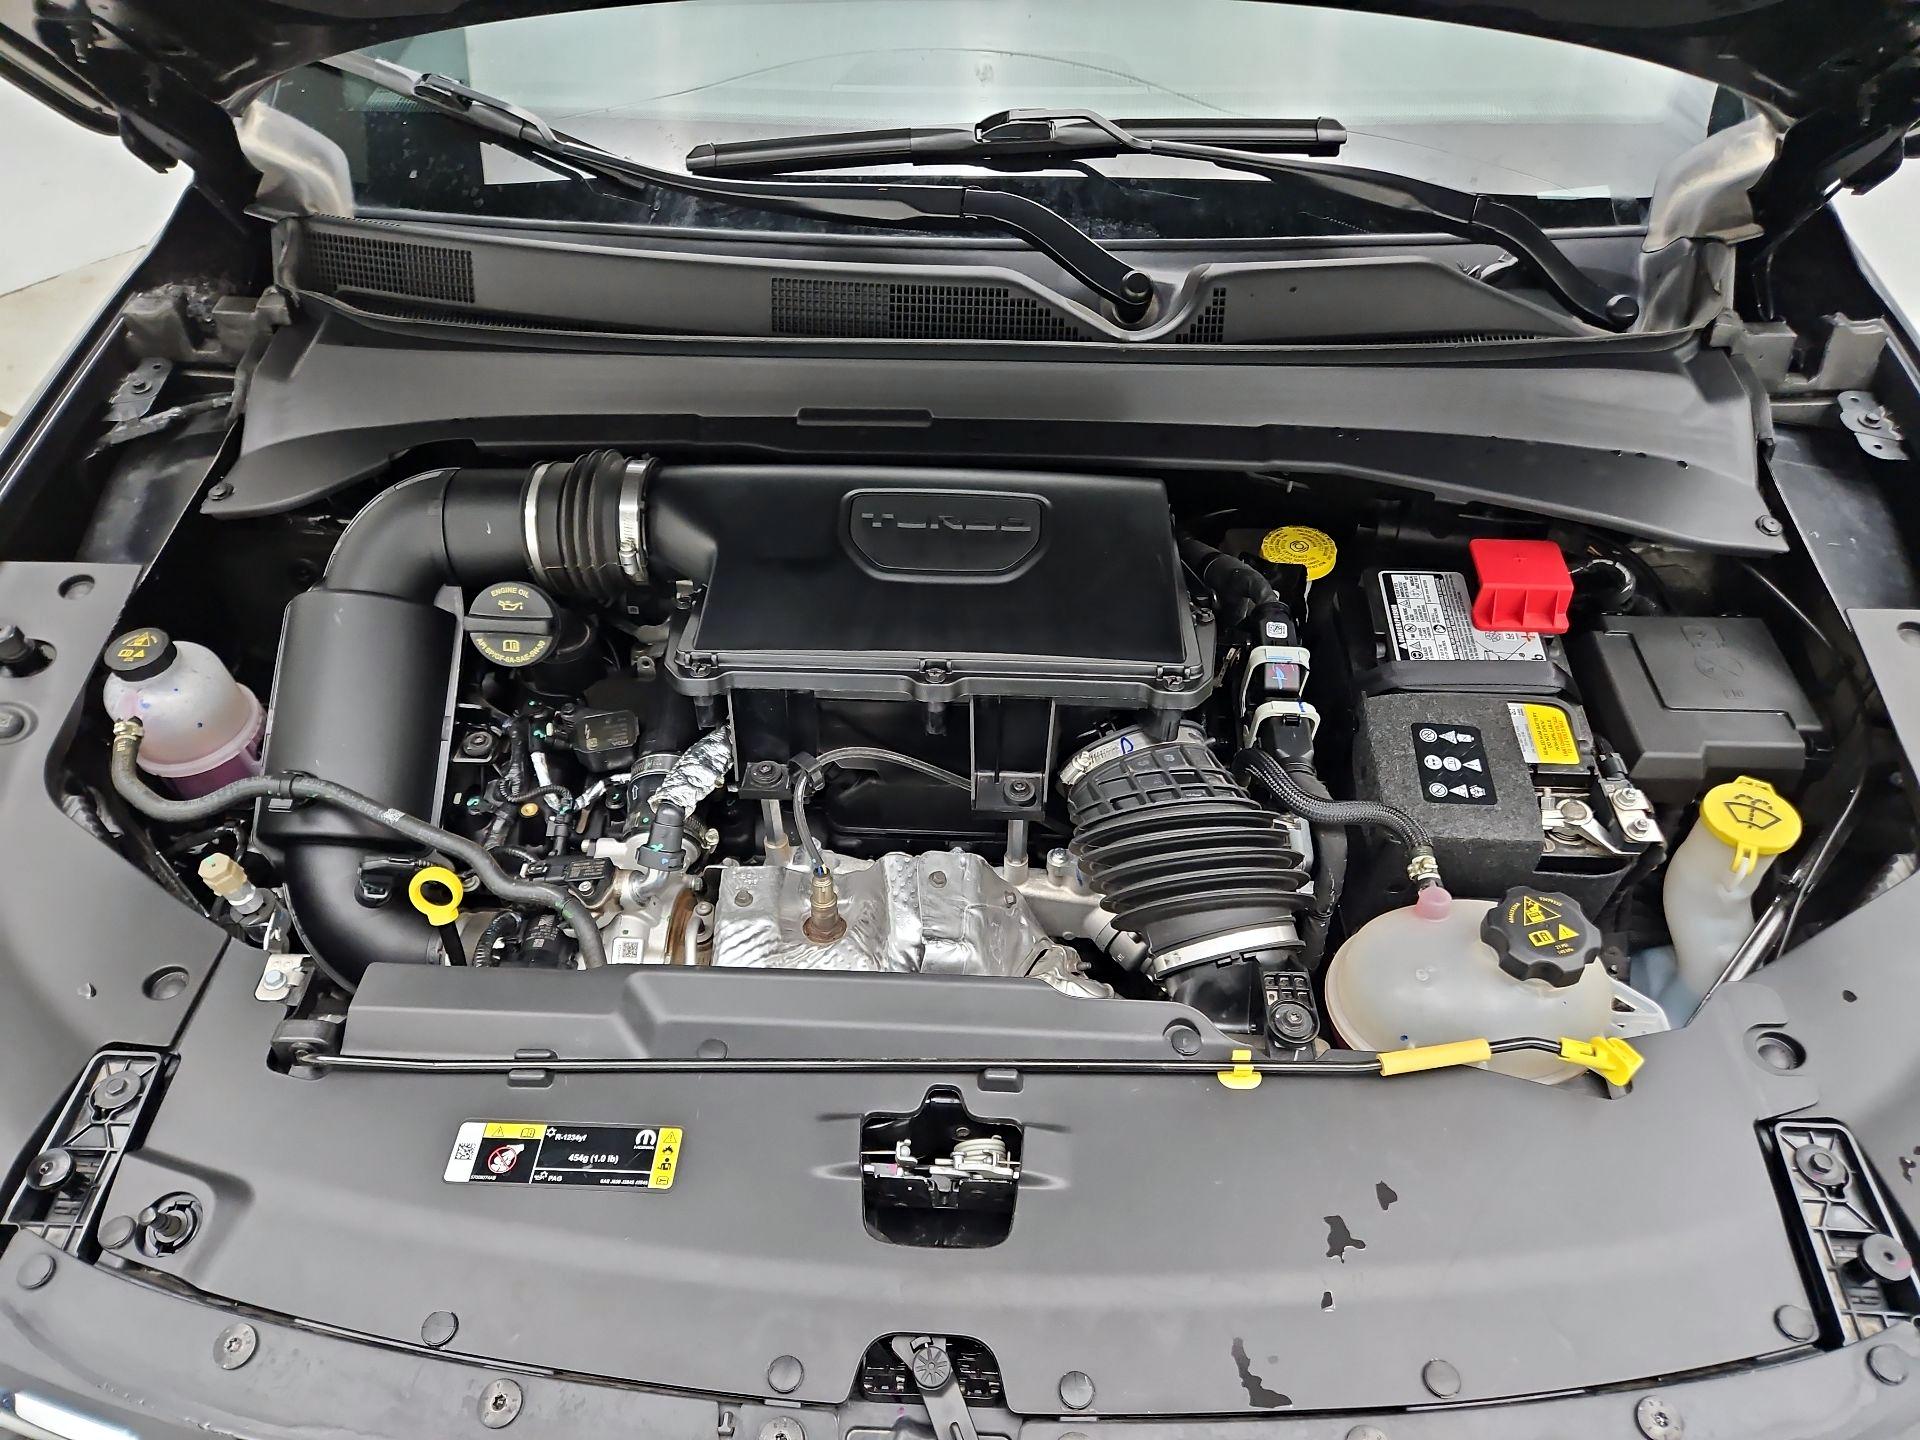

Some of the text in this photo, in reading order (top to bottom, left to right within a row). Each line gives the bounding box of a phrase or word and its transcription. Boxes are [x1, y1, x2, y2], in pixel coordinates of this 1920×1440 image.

[490, 587, 530, 599] ENGINE OIL
[555, 1134, 588, 1143] R-1234yf
[567, 1153, 620, 1165] 454g (1.0 lb)
